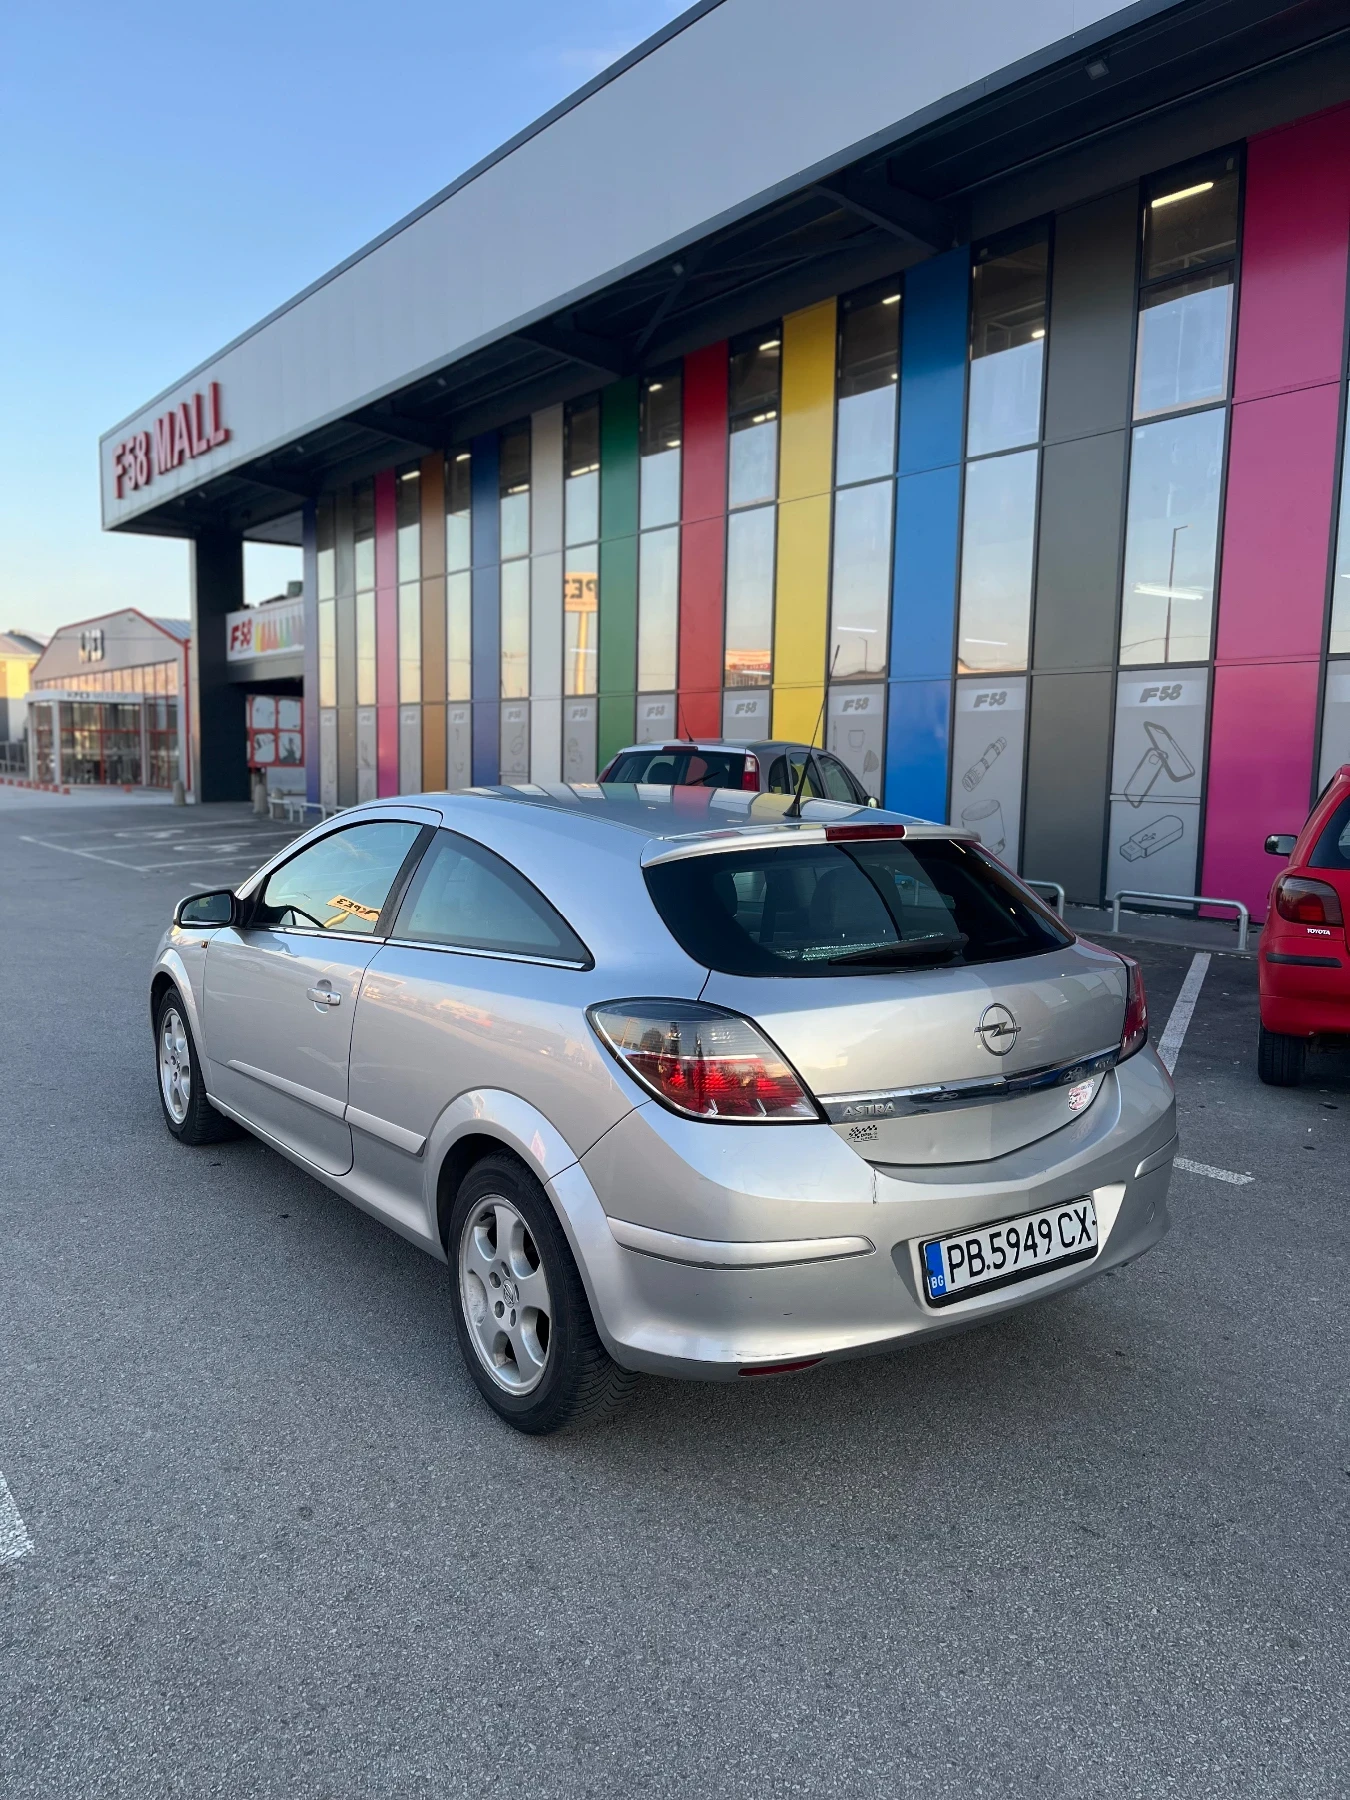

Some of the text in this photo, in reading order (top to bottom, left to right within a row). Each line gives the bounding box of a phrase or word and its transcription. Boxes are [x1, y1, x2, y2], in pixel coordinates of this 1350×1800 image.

[112, 382, 231, 499] F58 MALL
[973, 691, 1007, 708] F58
[1139, 683, 1183, 703] F58
[735, 701, 758, 715] F58
[842, 697, 870, 713] F58
[1307, 928, 1331, 936] TOYOTA
[842, 1101, 896, 1117] ASTRA
[931, 1275, 945, 1289] BG
